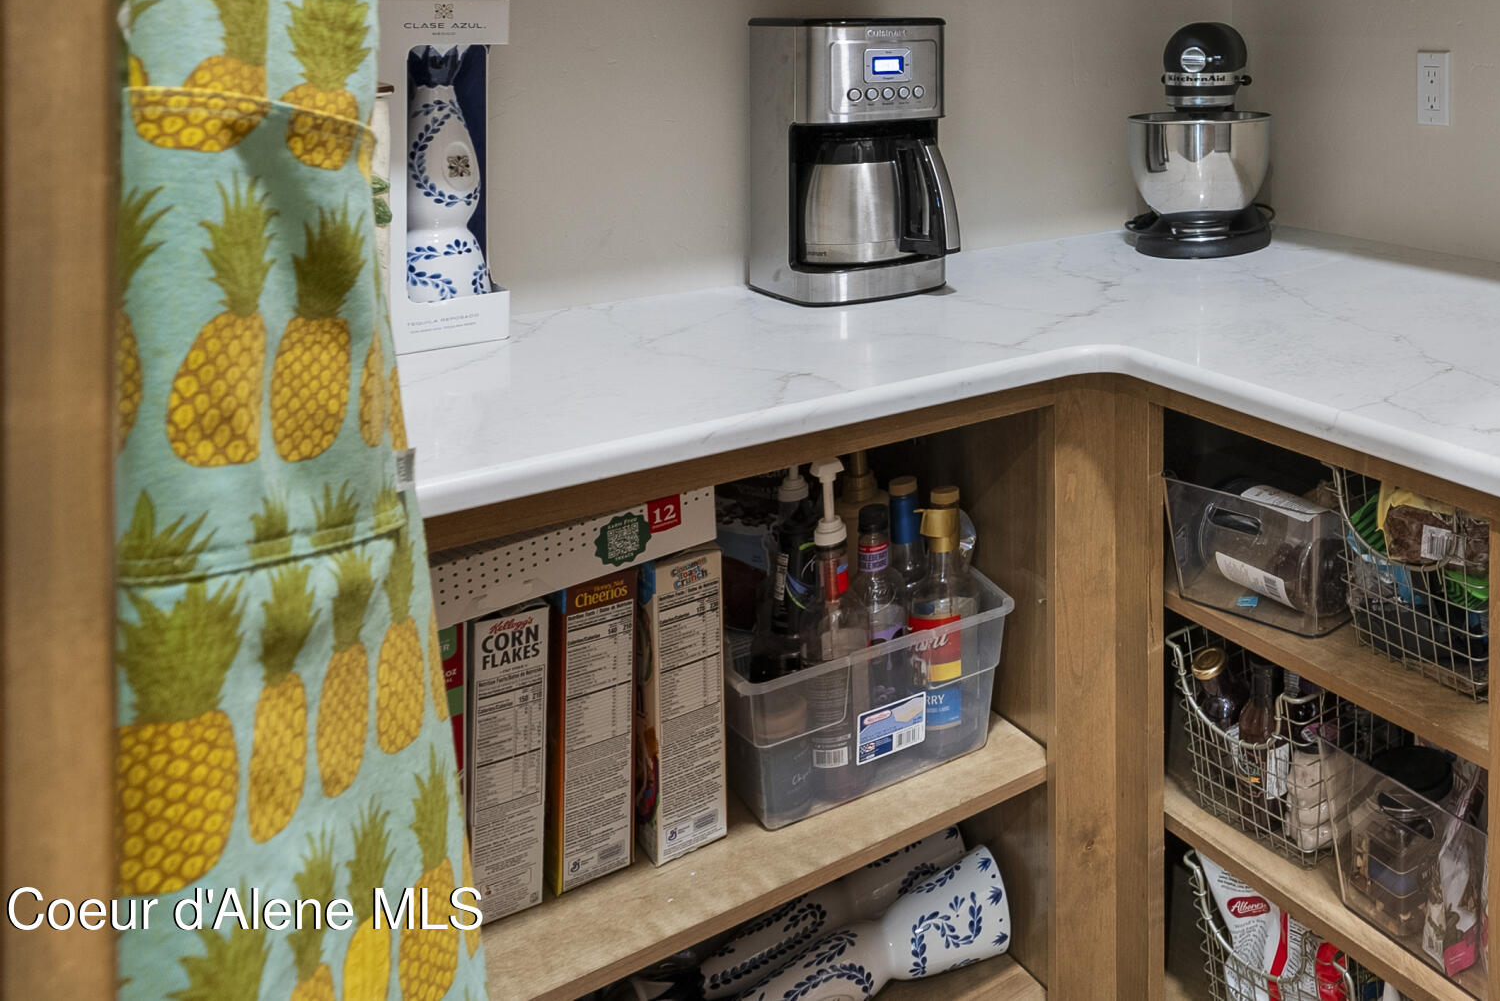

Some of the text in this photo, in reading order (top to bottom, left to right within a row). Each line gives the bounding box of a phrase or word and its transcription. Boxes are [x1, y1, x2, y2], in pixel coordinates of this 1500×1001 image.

[403, 22, 446, 30] CLASE
[866, 28, 908, 39] Cuisinart
[1167, 74, 1226, 82] KitchenAid
[652, 503, 677, 525] 12
[670, 556, 708, 577] Cinnamon
[676, 566, 702, 582] Toast
[593, 579, 625, 591] Honey Nut
[673, 569, 709, 591] Crunch
[574, 584, 629, 609] Cheerios
[489, 616, 534, 635] Kellogg's
[481, 624, 540, 654] CORN
[481, 642, 541, 671] FLAKES
